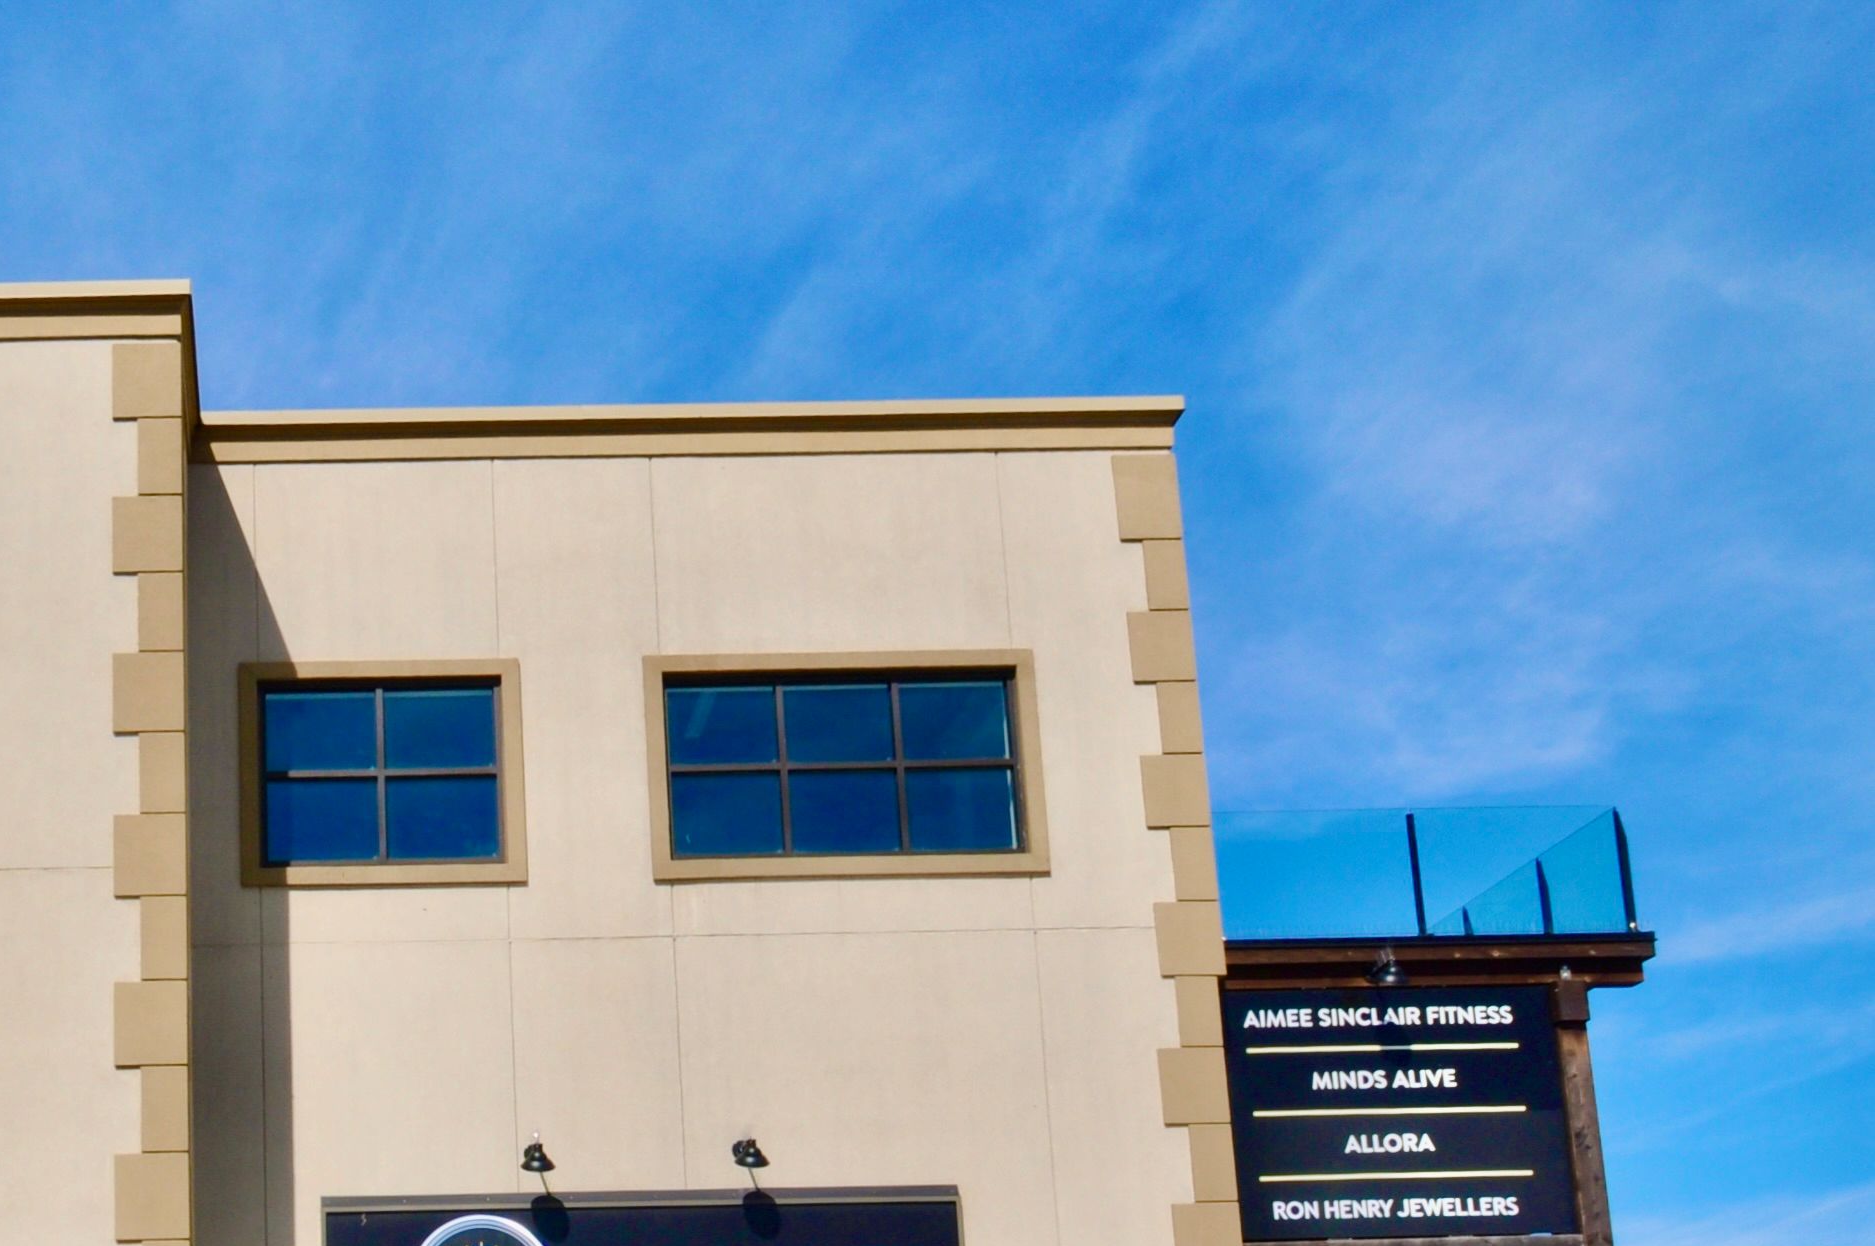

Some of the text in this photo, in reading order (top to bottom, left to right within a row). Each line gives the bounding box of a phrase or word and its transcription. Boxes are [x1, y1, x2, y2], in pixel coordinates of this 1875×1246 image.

[1243, 1004, 1514, 1029] AIMEE SINCLAIR FITNESS
[1311, 1068, 1458, 1091] MINDS ALIVE
[1344, 1132, 1437, 1155] ALLORA
[1272, 1196, 1521, 1221] RON HENRY JEWELLERS
